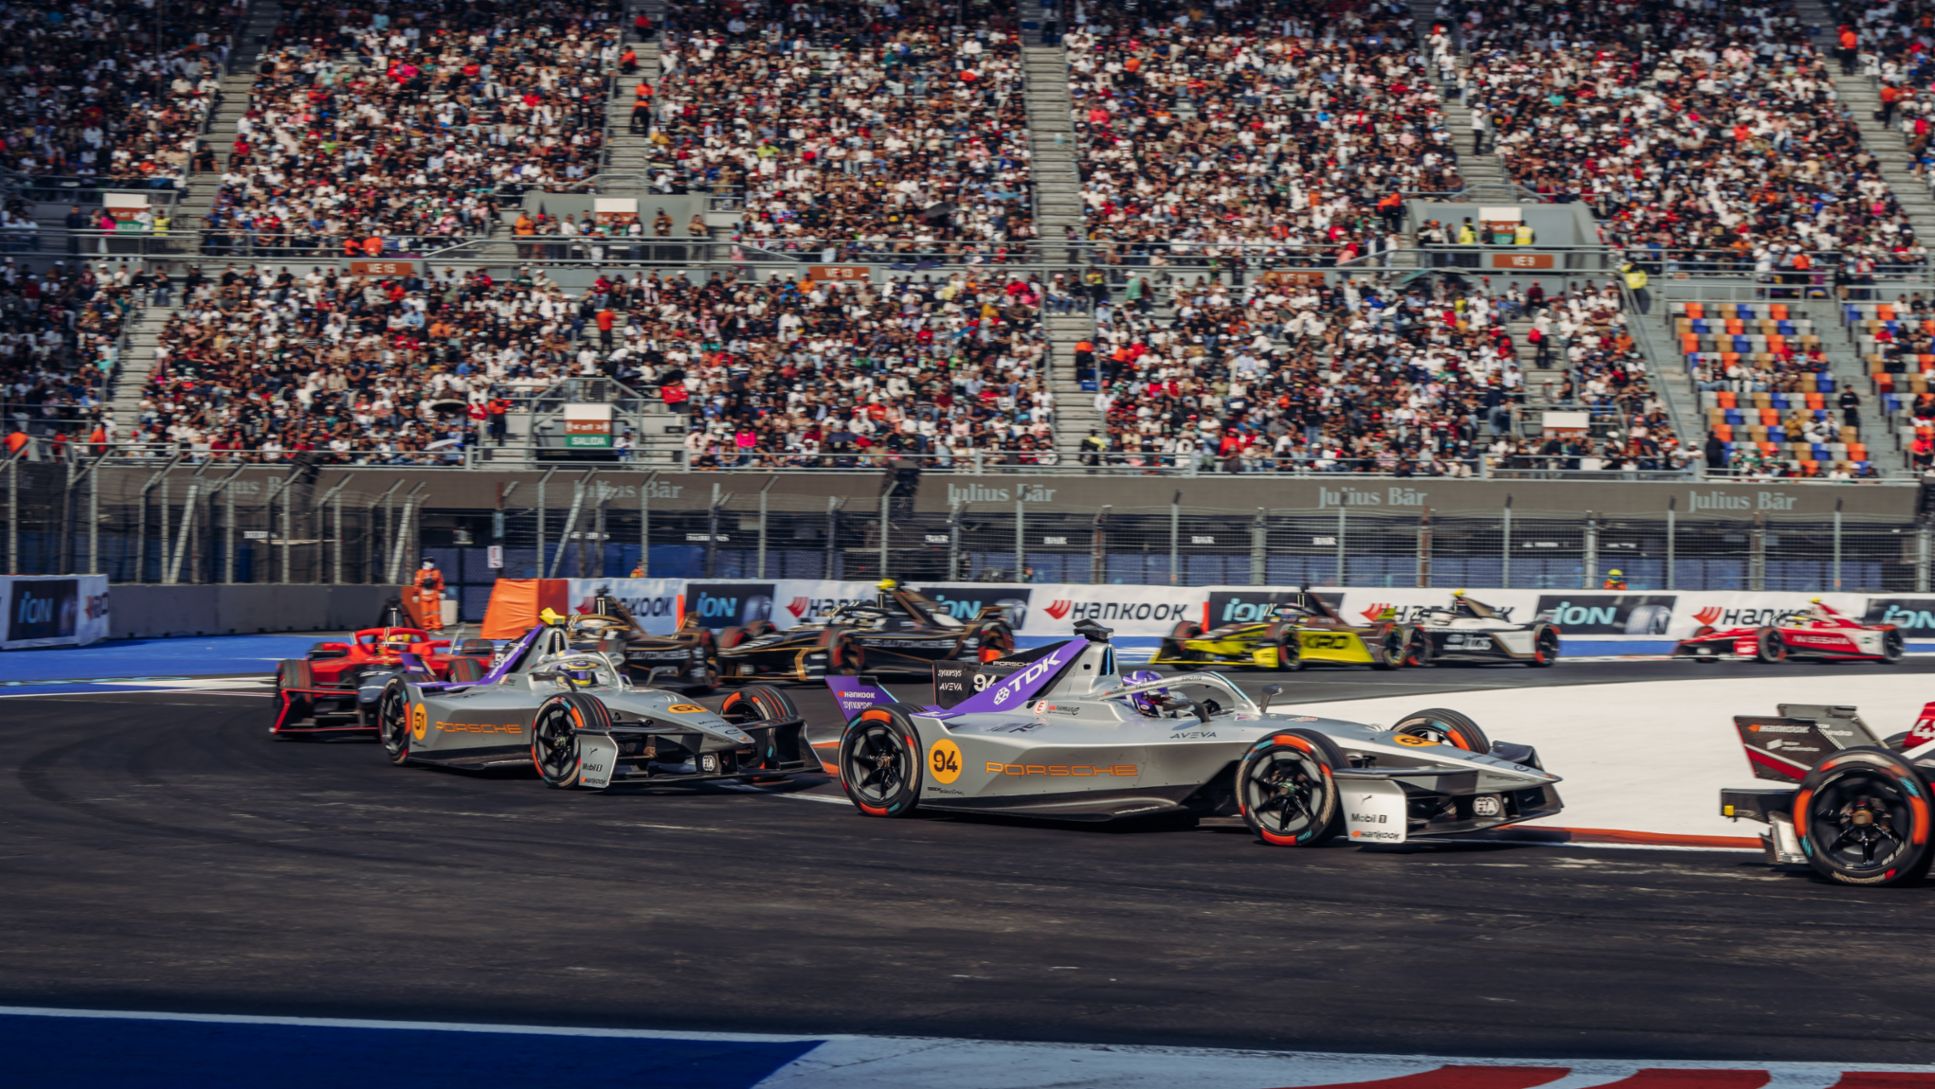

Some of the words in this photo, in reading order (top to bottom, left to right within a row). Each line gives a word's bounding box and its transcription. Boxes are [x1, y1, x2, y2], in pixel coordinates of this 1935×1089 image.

[367, 263, 383, 274] VE
[1688, 490, 1751, 513] Julius
[1552, 601, 1618, 626] iON
[1008, 649, 1061, 692] TDK
[414, 711, 425, 731] 51
[435, 721, 523, 735] PORSCHE
[1169, 731, 1218, 740] AVEVA
[933, 749, 958, 773] 94
[985, 760, 1138, 777] PORSCHE
[1475, 800, 1498, 813] FIA
[1351, 813, 1376, 824] Mobil
